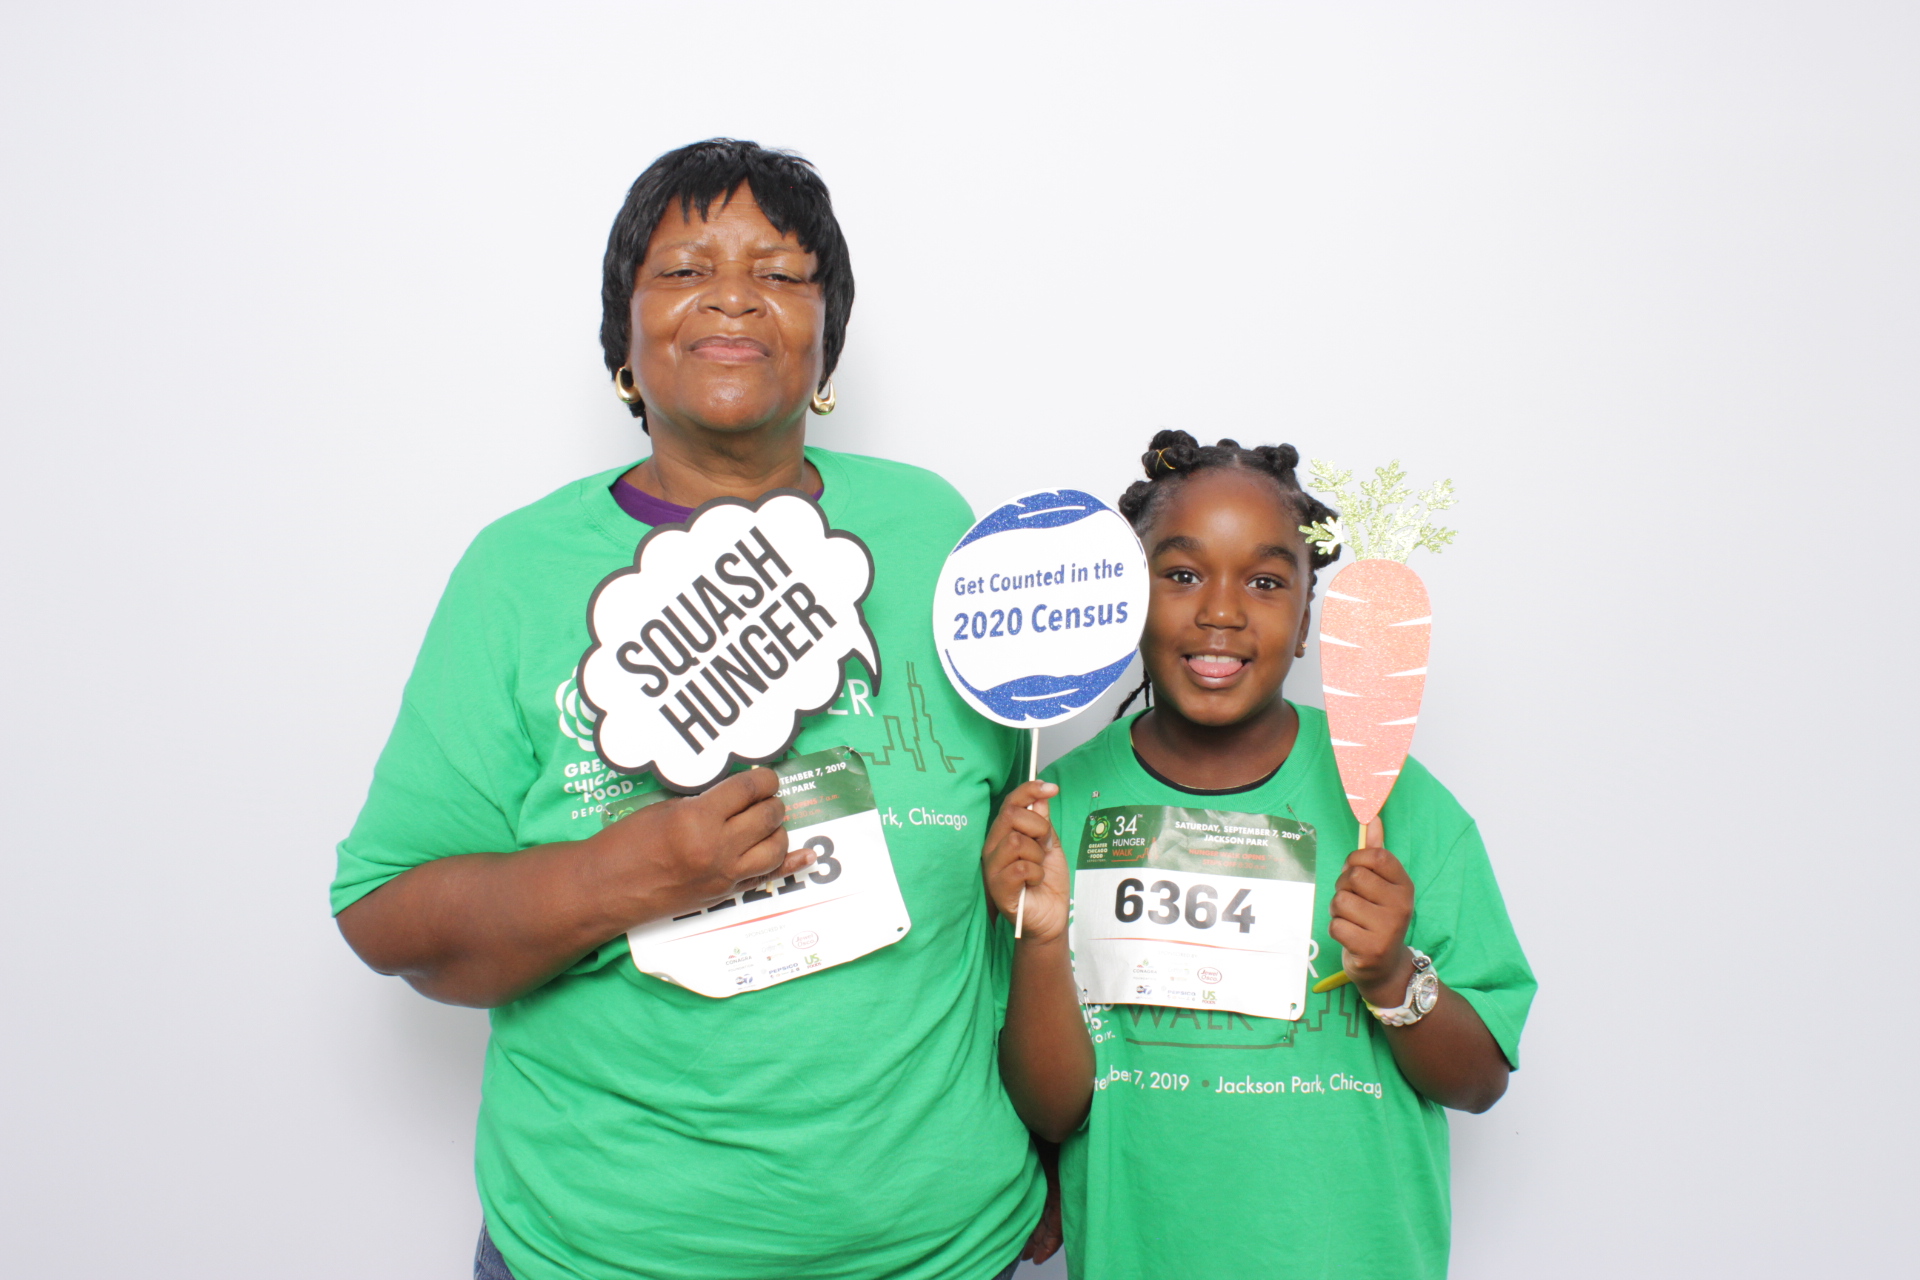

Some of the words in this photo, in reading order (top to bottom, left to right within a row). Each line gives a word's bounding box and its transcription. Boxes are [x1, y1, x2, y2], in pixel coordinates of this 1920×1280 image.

[955, 576, 984, 596] Get
[990, 564, 1065, 592] Counted
[1071, 563, 1088, 583] in
[1094, 558, 1124, 580] the
[616, 526, 792, 697] SQUASH
[953, 606, 1023, 641] 2020
[1031, 601, 1128, 633] Census
[658, 582, 837, 755] HUNGER
[563, 769, 626, 794] CHICA
[779, 769, 814, 785] TEMBER
[815, 768, 823, 777] 7,
[825, 762, 846, 774] 2019
[791, 781, 816, 794] PARK
[879, 807, 903, 828] rk,
[908, 807, 968, 830] Chicago
[1175, 821, 1220, 833] SATURDAY,
[1223, 825, 1270, 837] SEPTEMBER
[1271, 829, 1279, 838] 7,
[1281, 831, 1301, 841] 2019
[1204, 834, 1245, 845] JACKSON
[1245, 838, 1269, 847] PARK
[1112, 838, 1145, 847] HUNGER
[1188, 848, 1219, 857] HUNGER
[1242, 853, 1266, 861] OPENS
[1114, 877, 1256, 934] 6364
[725, 955, 753, 966] CONAGRA
[768, 962, 799, 975] PEPSICO
[1201, 969, 1219, 977] Jewel
[1167, 989, 1197, 997] PEPSICO
[1133, 1069, 1145, 1090] 7,
[1149, 1071, 1190, 1092] 2019
[1215, 1075, 1285, 1094] Jackson
[1291, 1076, 1325, 1094] Park,
[1329, 1073, 1383, 1099] Chicag
